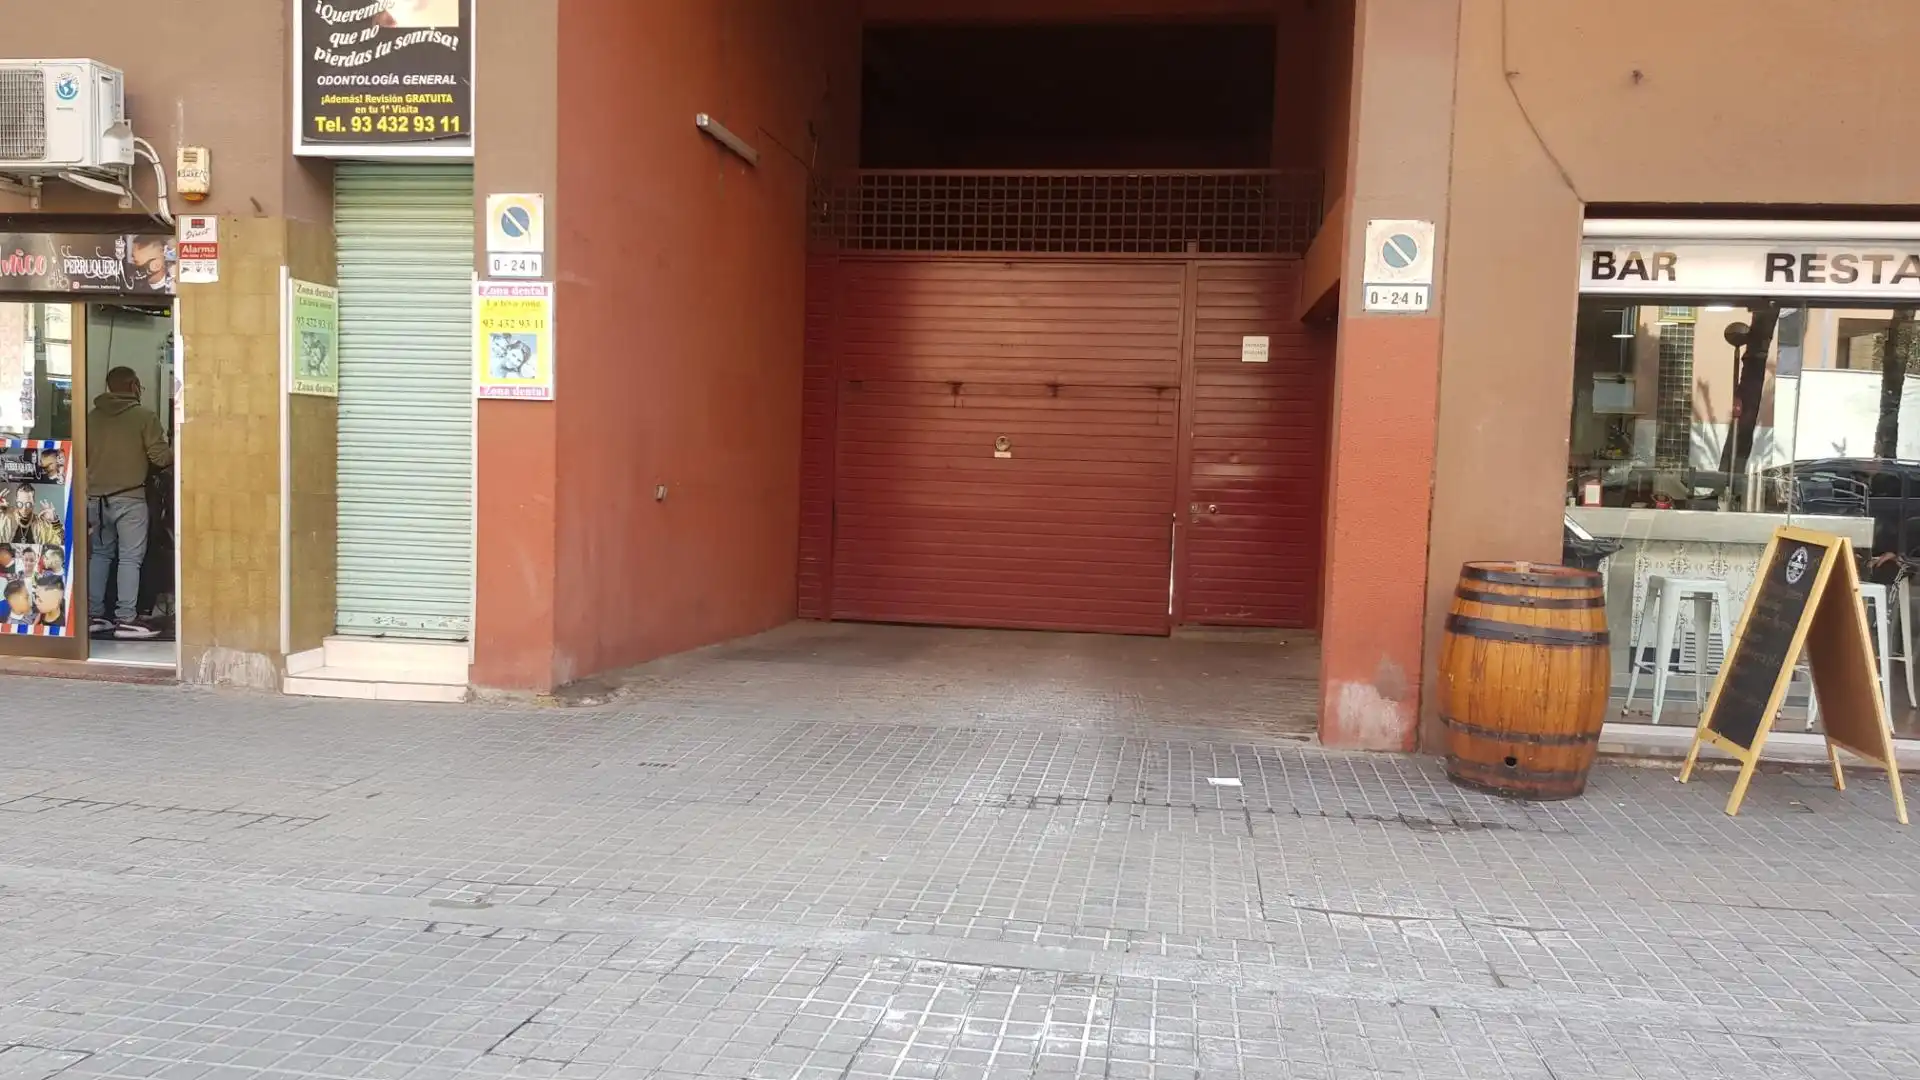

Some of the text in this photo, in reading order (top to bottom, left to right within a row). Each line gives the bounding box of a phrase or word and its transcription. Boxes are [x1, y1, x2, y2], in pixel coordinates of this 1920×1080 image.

[329, 25, 380, 48] que no
[314, 26, 459, 68] pierdas tu sonrisa!
[317, 73, 457, 86] ODONTOLOGÍA GENERAL
[321, 94, 453, 105] ¡Además! Revisión GRATUITA
[355, 106, 367, 114] en
[368, 105, 378, 114] tu
[392, 105, 419, 114] Visita
[315, 116, 460, 132] Tel. 93 432 93 11
[182, 244, 216, 253] Alarma
[531, 260, 538, 272] h
[1591, 250, 1920, 284] BAR RESTA
[483, 285, 545, 296] Zona dental
[1415, 292, 1423, 305] h
[482, 319, 544, 329] 93 432 93 11
[483, 384, 545, 398] Zona dental
